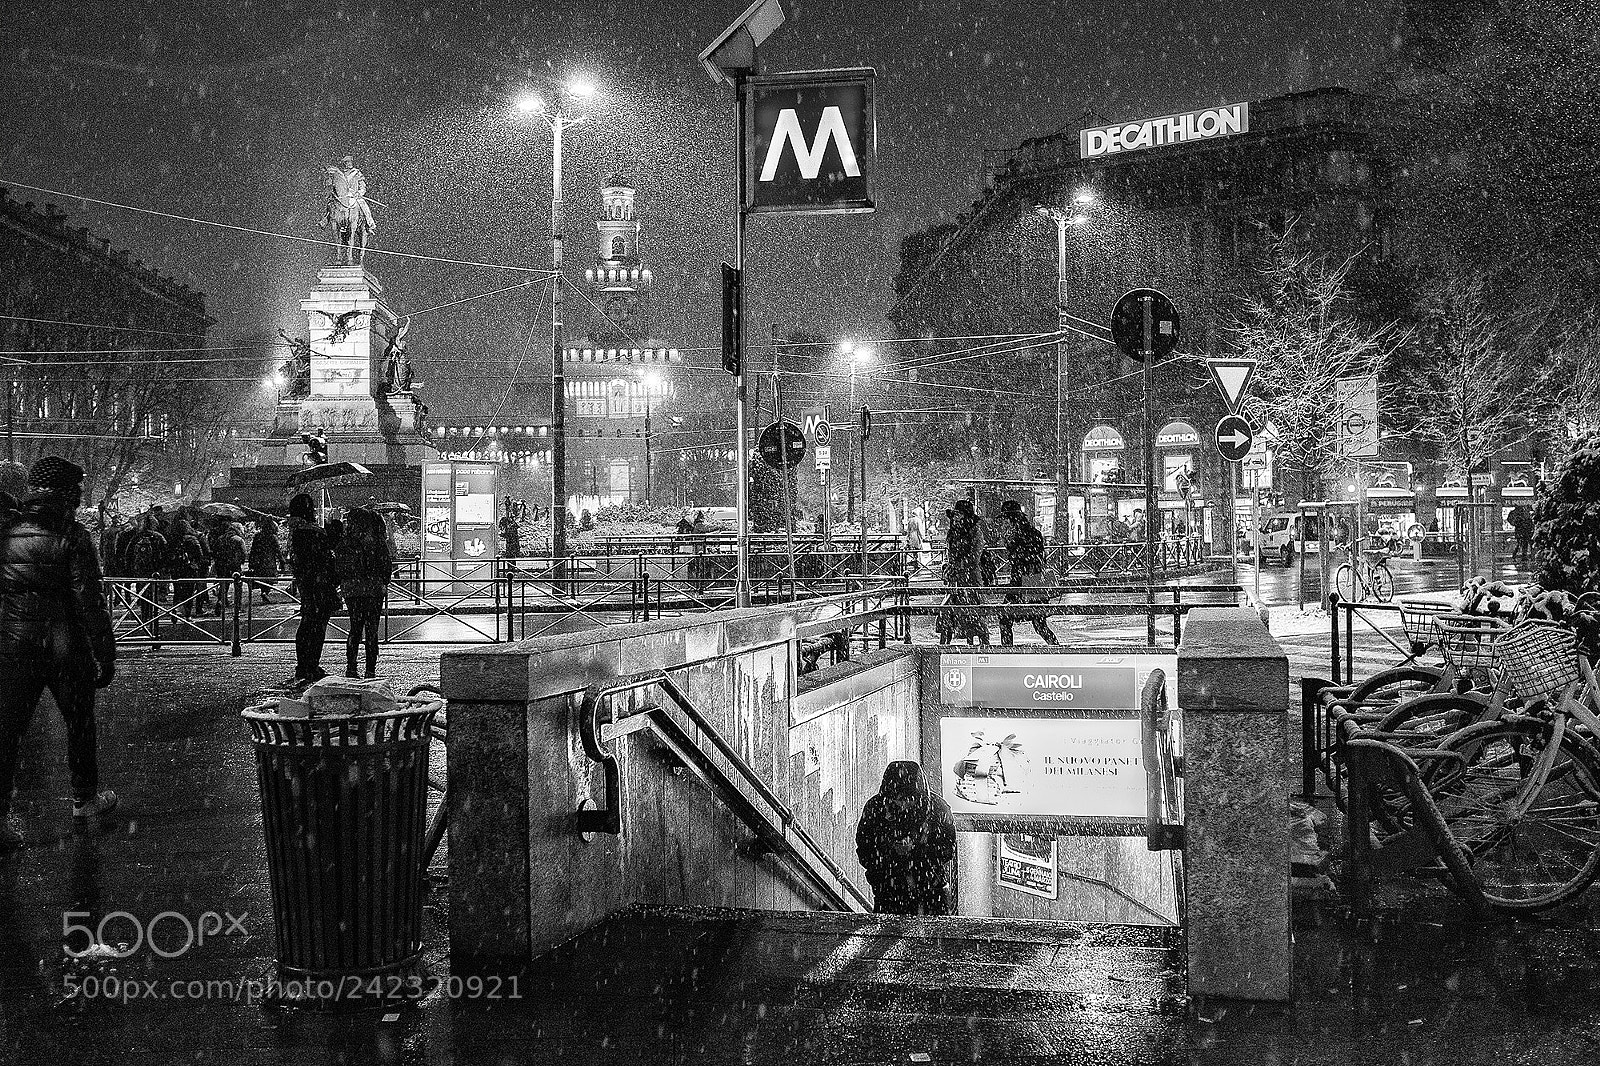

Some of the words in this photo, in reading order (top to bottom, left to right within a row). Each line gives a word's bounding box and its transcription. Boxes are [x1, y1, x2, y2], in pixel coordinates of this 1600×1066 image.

[1087, 105, 1241, 156] DECATHLON
[759, 106, 861, 181] M
[941, 656, 967, 665] Milano
[1023, 674, 1083, 689] CAIROLI
[1032, 690, 1074, 701] Castello
[1057, 756, 1101, 766] NUOVO
[1044, 766, 1064, 775] DEI
[1067, 766, 1118, 776] MILANESI
